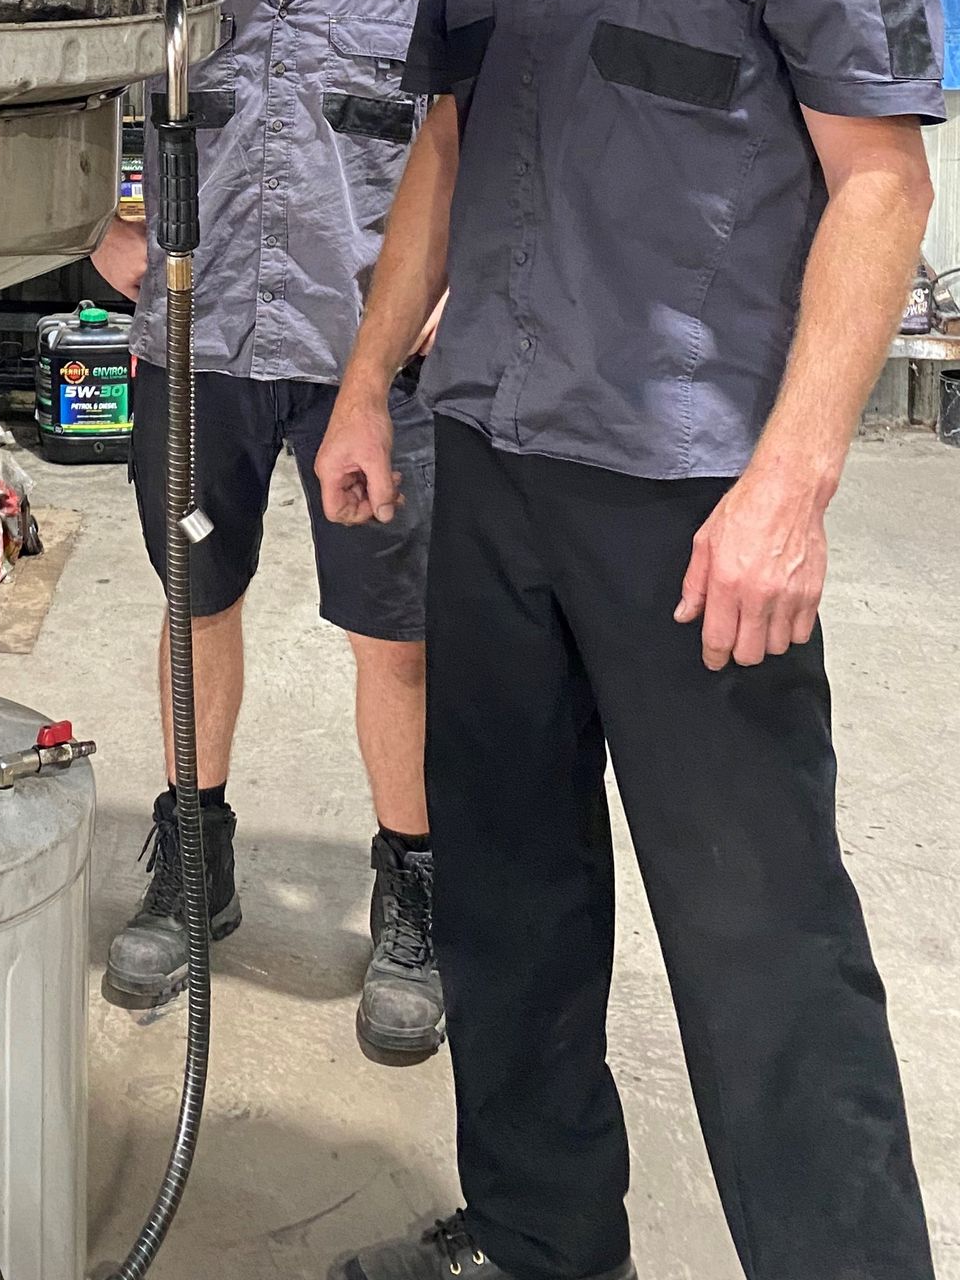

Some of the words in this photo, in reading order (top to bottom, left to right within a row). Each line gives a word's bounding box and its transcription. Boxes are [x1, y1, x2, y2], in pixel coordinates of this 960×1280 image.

[59, 368, 89, 376] PENRITE
[92, 365, 128, 377] ENVIRO+
[64, 385, 124, 398] 5W-30
[98, 402, 118, 410] DIESEL
